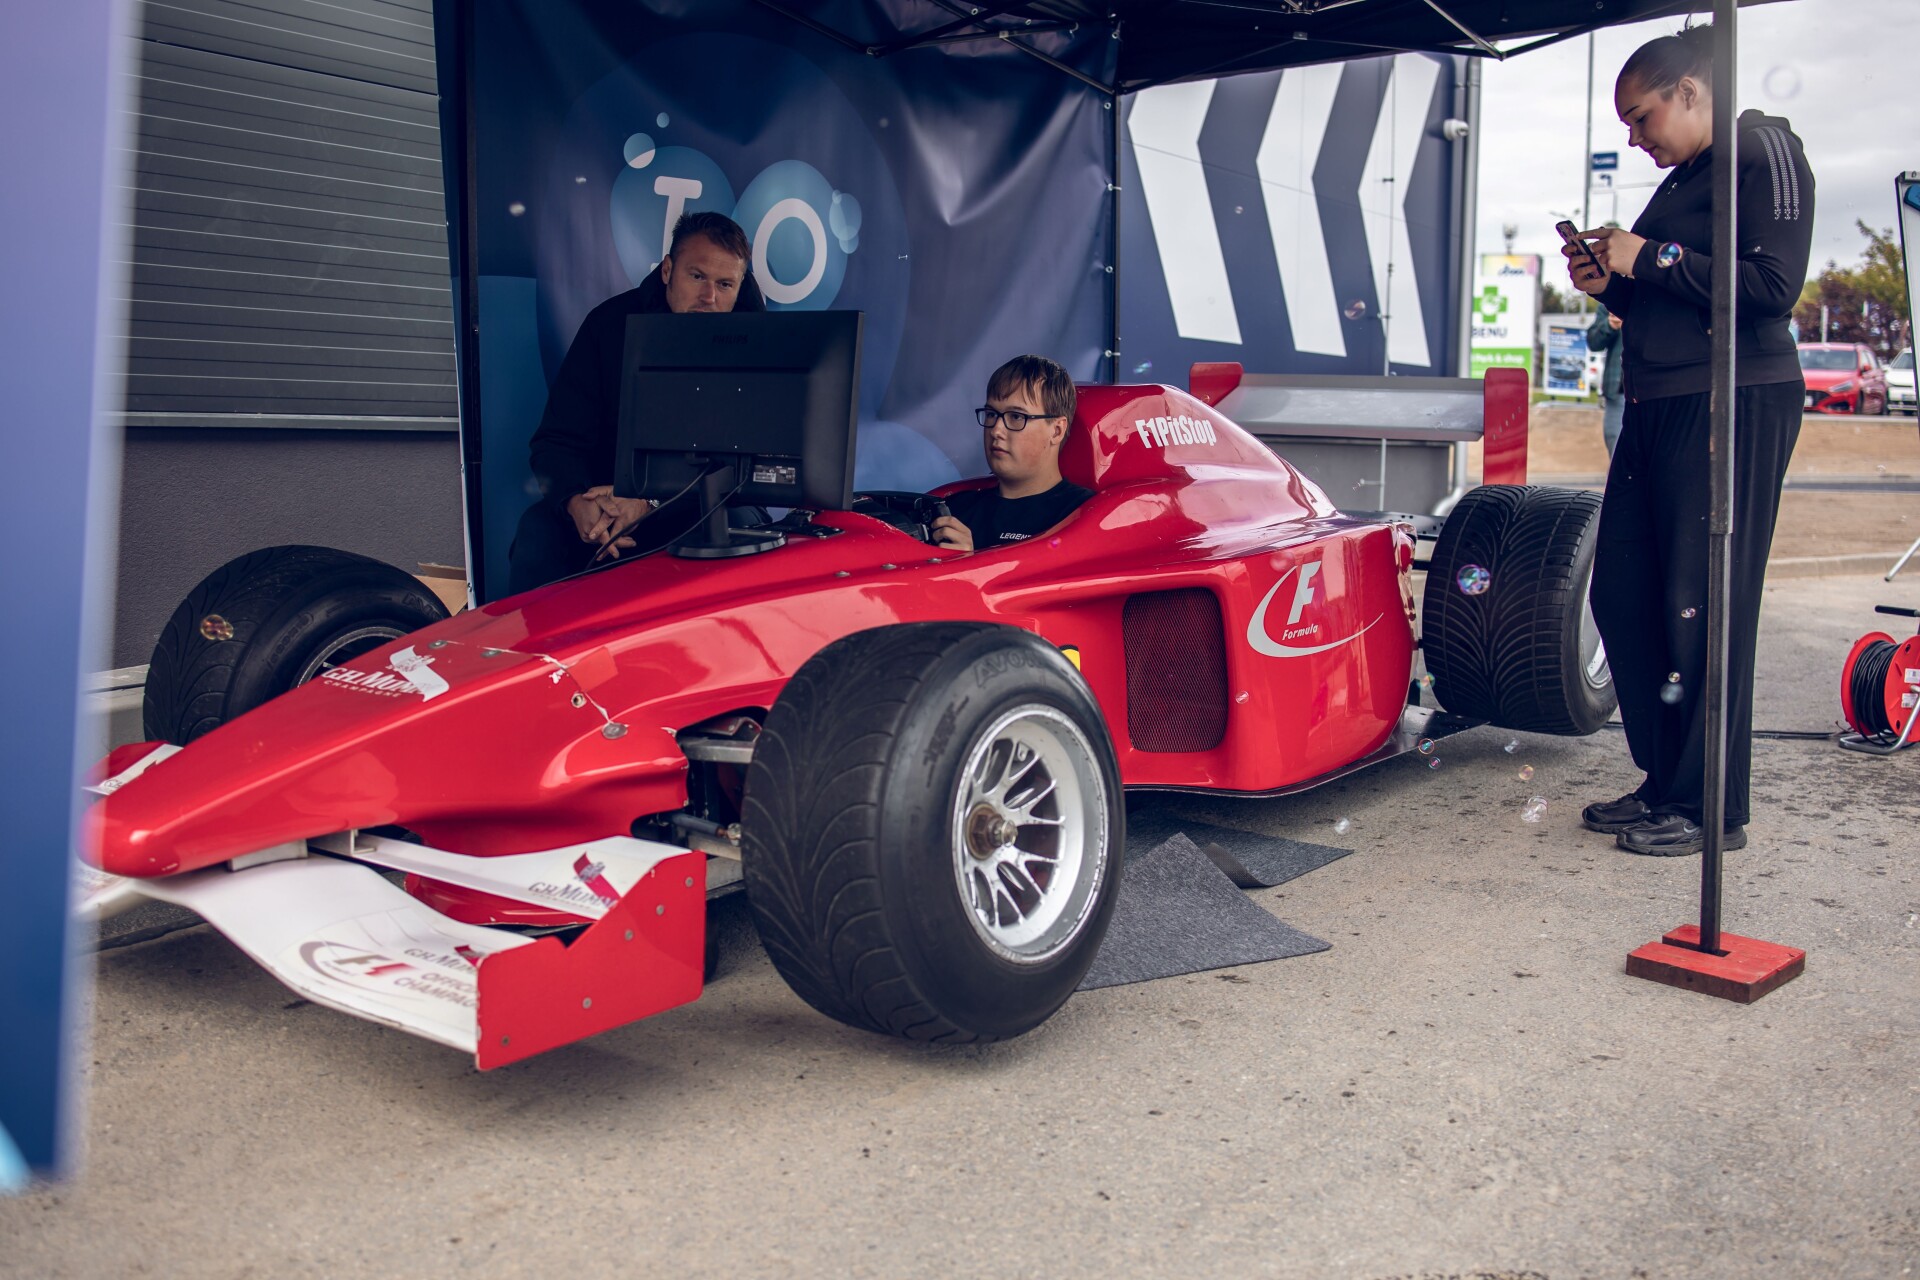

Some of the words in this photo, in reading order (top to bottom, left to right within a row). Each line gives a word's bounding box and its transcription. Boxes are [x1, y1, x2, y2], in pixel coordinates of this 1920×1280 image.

[1135, 415, 1217, 448] F1PitStop
[1282, 624, 1318, 641] Formula
[323, 680, 401, 697] CHAMPAGNE
[394, 977, 477, 1008] CHAMPAG
